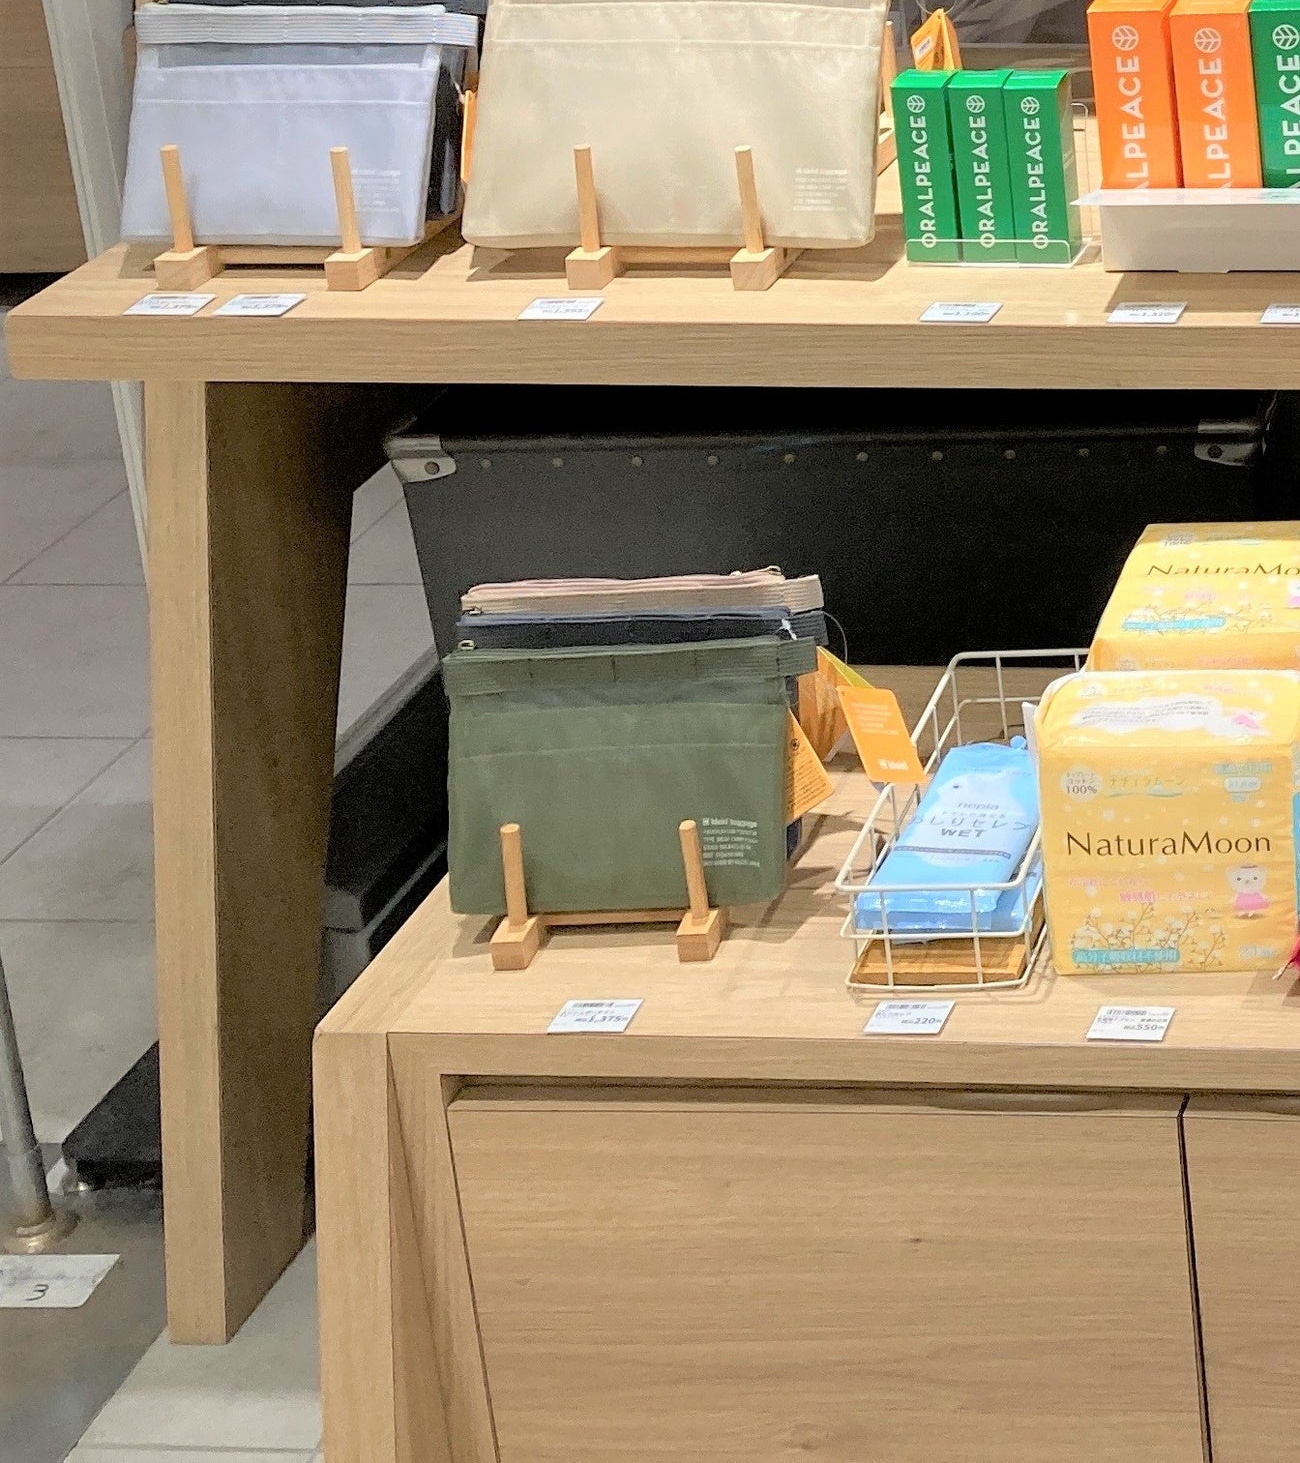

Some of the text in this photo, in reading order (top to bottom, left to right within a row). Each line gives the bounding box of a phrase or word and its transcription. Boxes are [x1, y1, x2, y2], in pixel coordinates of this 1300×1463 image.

[906, 115, 938, 249] ORALPEACE
[965, 115, 997, 249] ORALPEACE
[1021, 116, 1050, 250] ORALPEACE
[940, 828, 986, 839] WET
[1066, 831, 1271, 857] NaturaMoon
